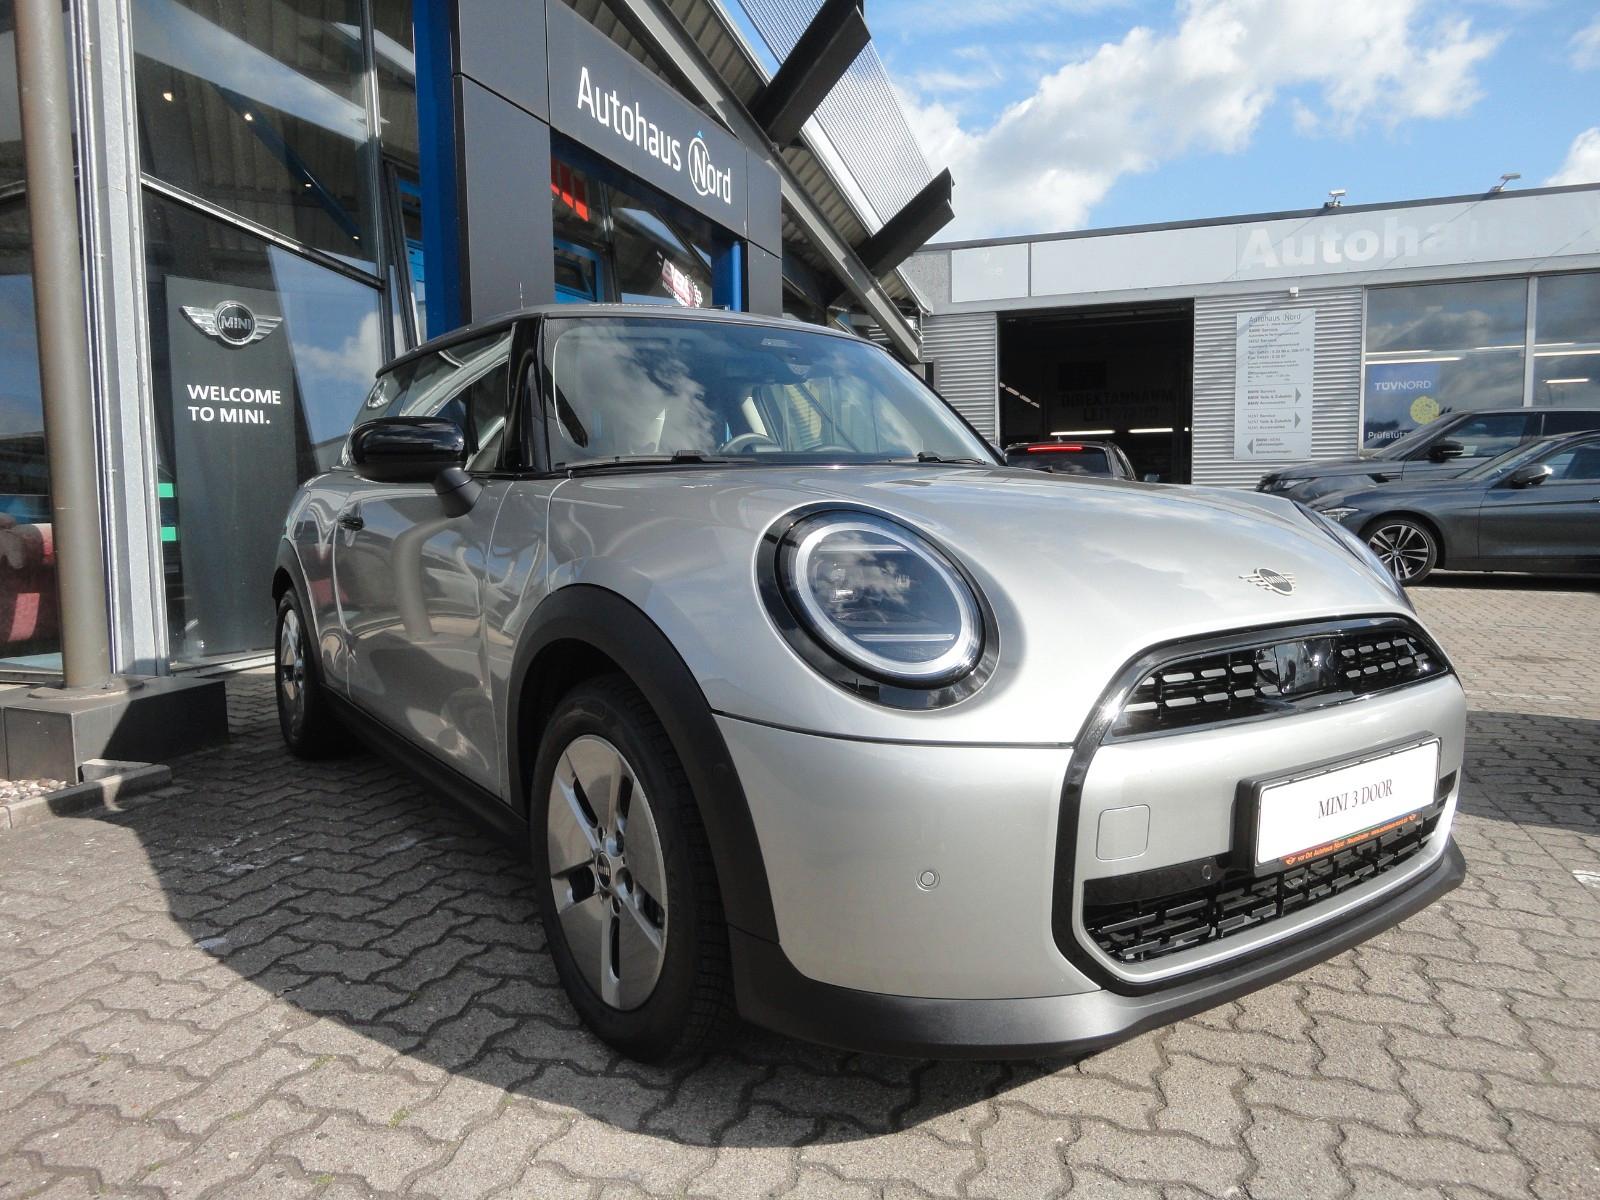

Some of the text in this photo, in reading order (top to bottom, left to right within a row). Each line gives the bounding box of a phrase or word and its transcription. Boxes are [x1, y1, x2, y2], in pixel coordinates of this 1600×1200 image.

[577, 66, 731, 205] Autohaus Nord
[221, 316, 251, 329] MINI
[1248, 313, 1301, 323] Autohaus Nord
[187, 384, 281, 405] WELCOME
[187, 406, 271, 425] TO MINI.
[1318, 778, 1393, 819] MINI 3 DOOR
